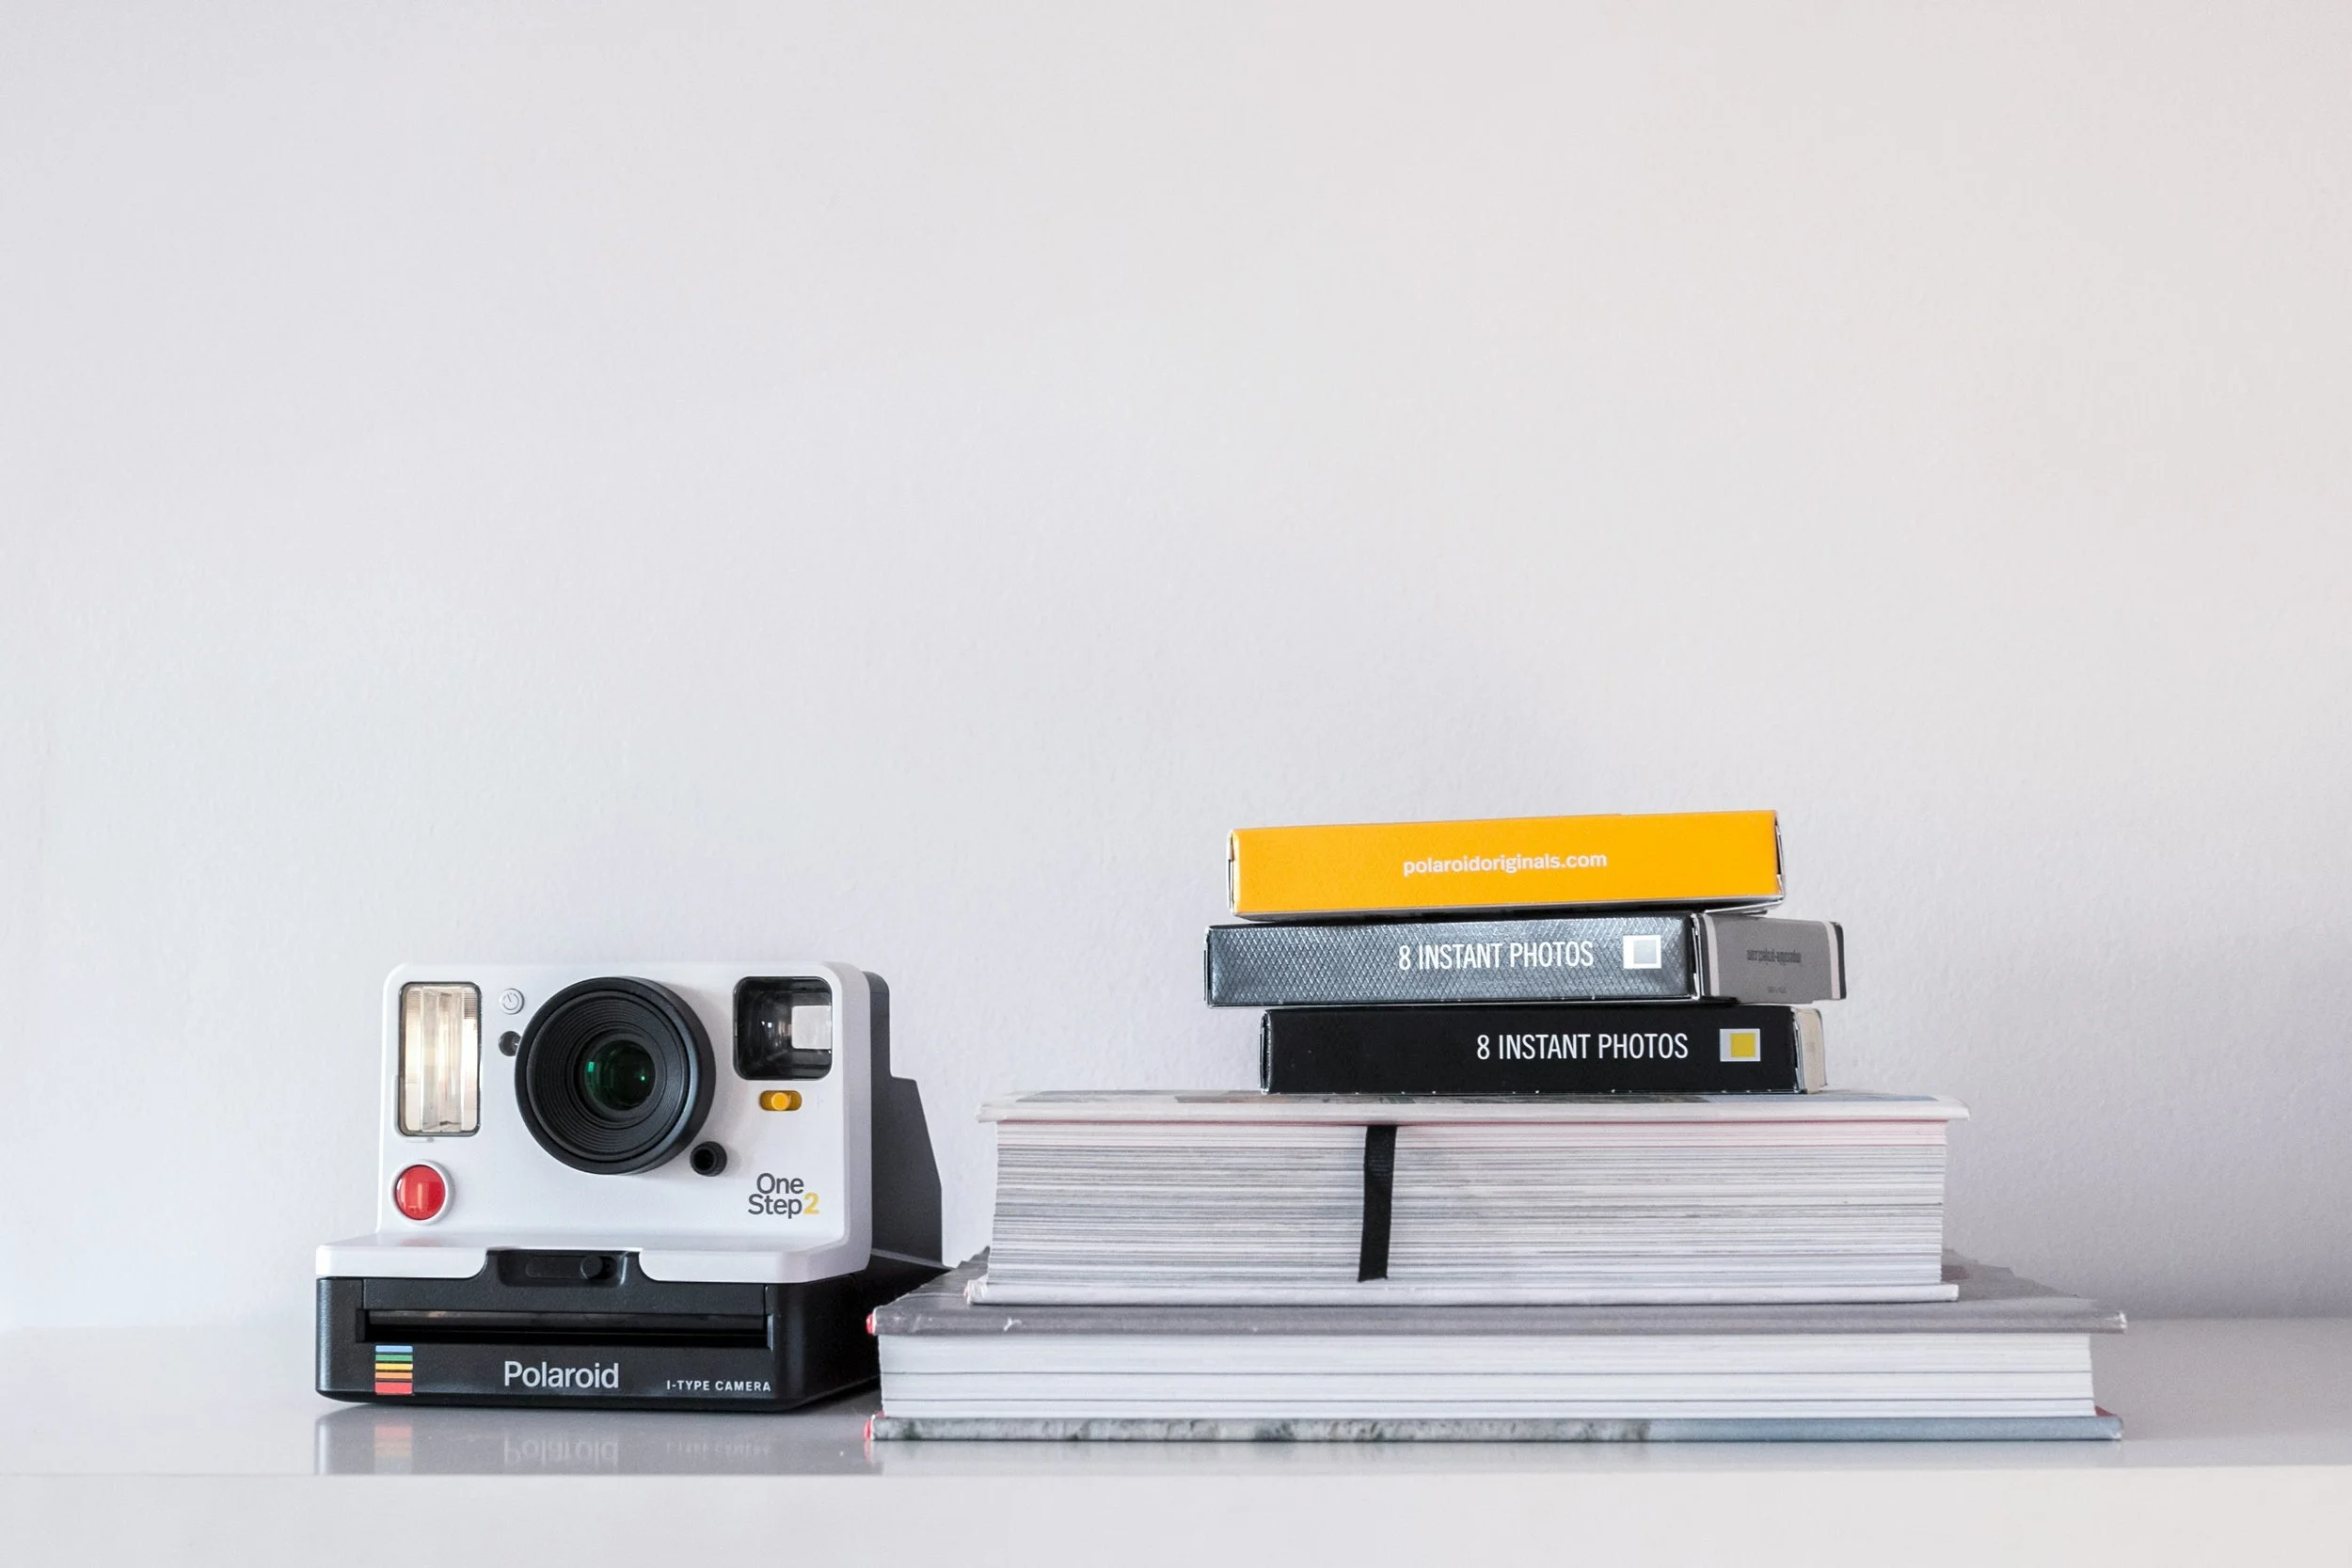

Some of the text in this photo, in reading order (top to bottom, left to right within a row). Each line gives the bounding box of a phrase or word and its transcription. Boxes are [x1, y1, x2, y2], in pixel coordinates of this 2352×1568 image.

[1403, 853, 1608, 878] polaroidoriginals.com
[1398, 941, 1595, 971] 8 INSTANT PHOTOS
[1476, 1033, 1689, 1060] 8 INSTANT PHOTOS
[755, 1172, 804, 1195] One
[504, 1360, 619, 1389] Polaroid
[666, 1379, 771, 1392] I-TYPE CAMERA
